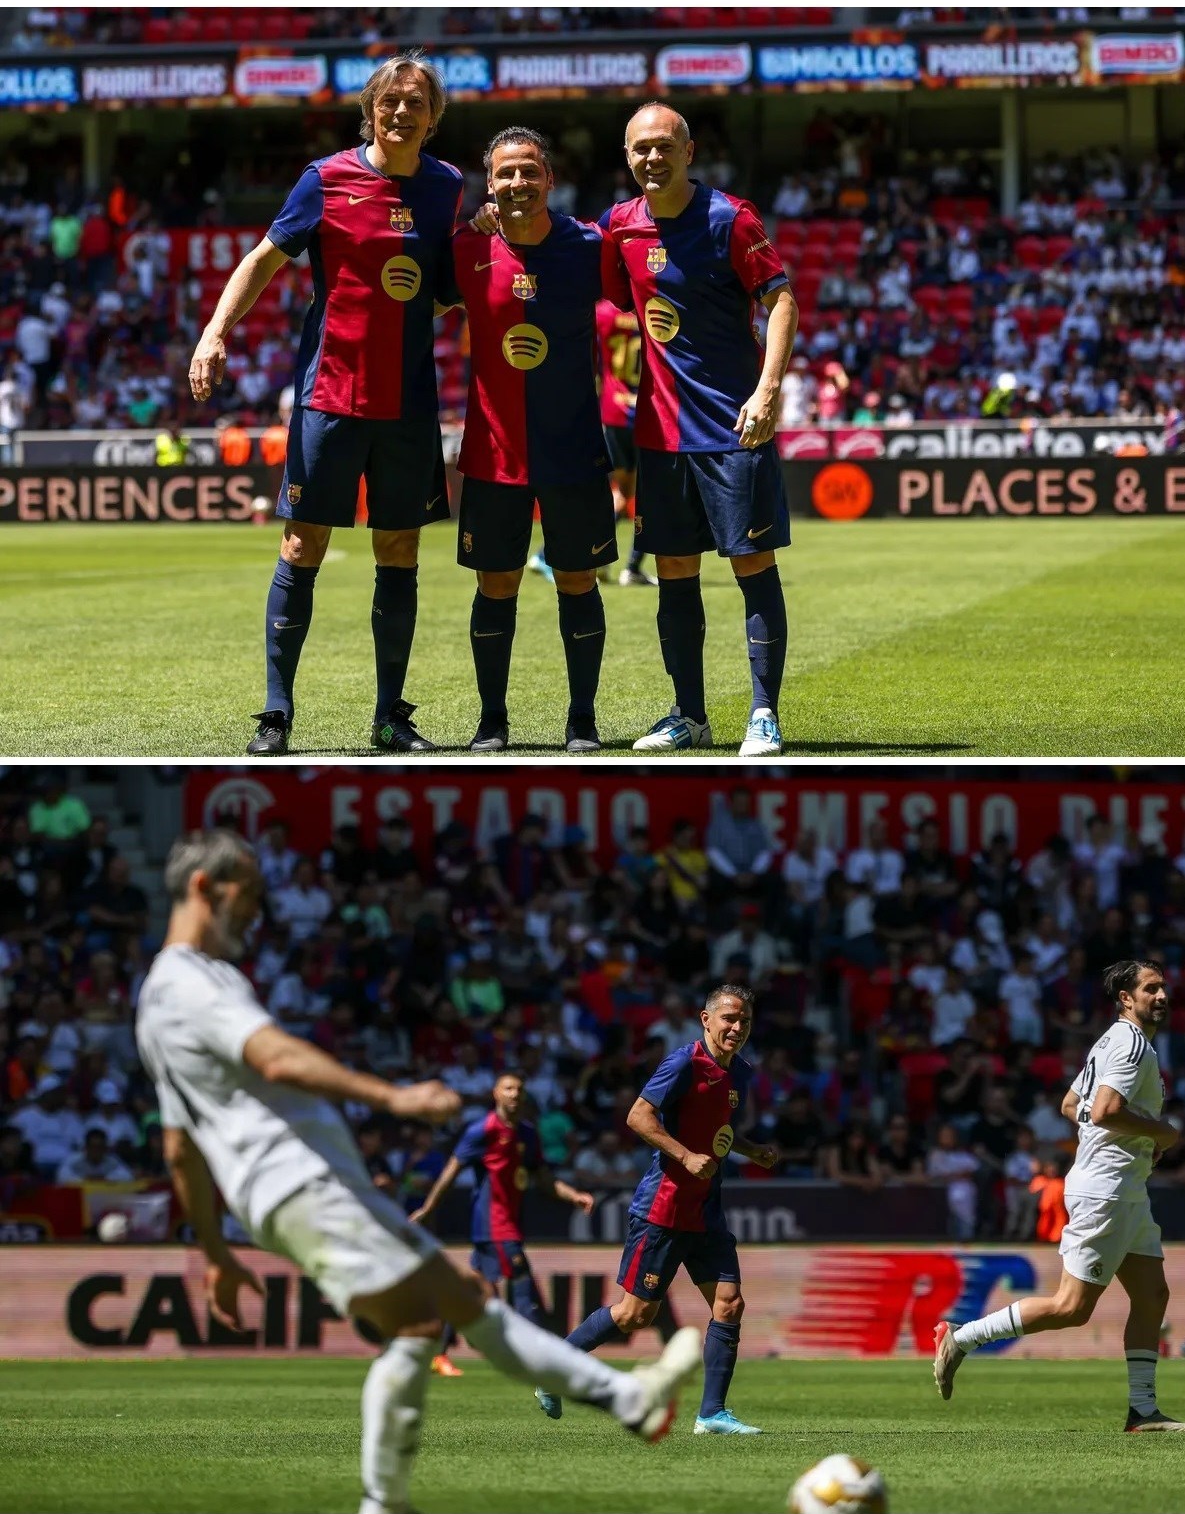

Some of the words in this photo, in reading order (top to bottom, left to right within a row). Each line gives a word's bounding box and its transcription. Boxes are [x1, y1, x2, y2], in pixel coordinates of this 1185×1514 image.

[927, 43, 1080, 78] PARRILLEROS
[899, 469, 1097, 514] PLACES
[1114, 466, 1147, 512] &
